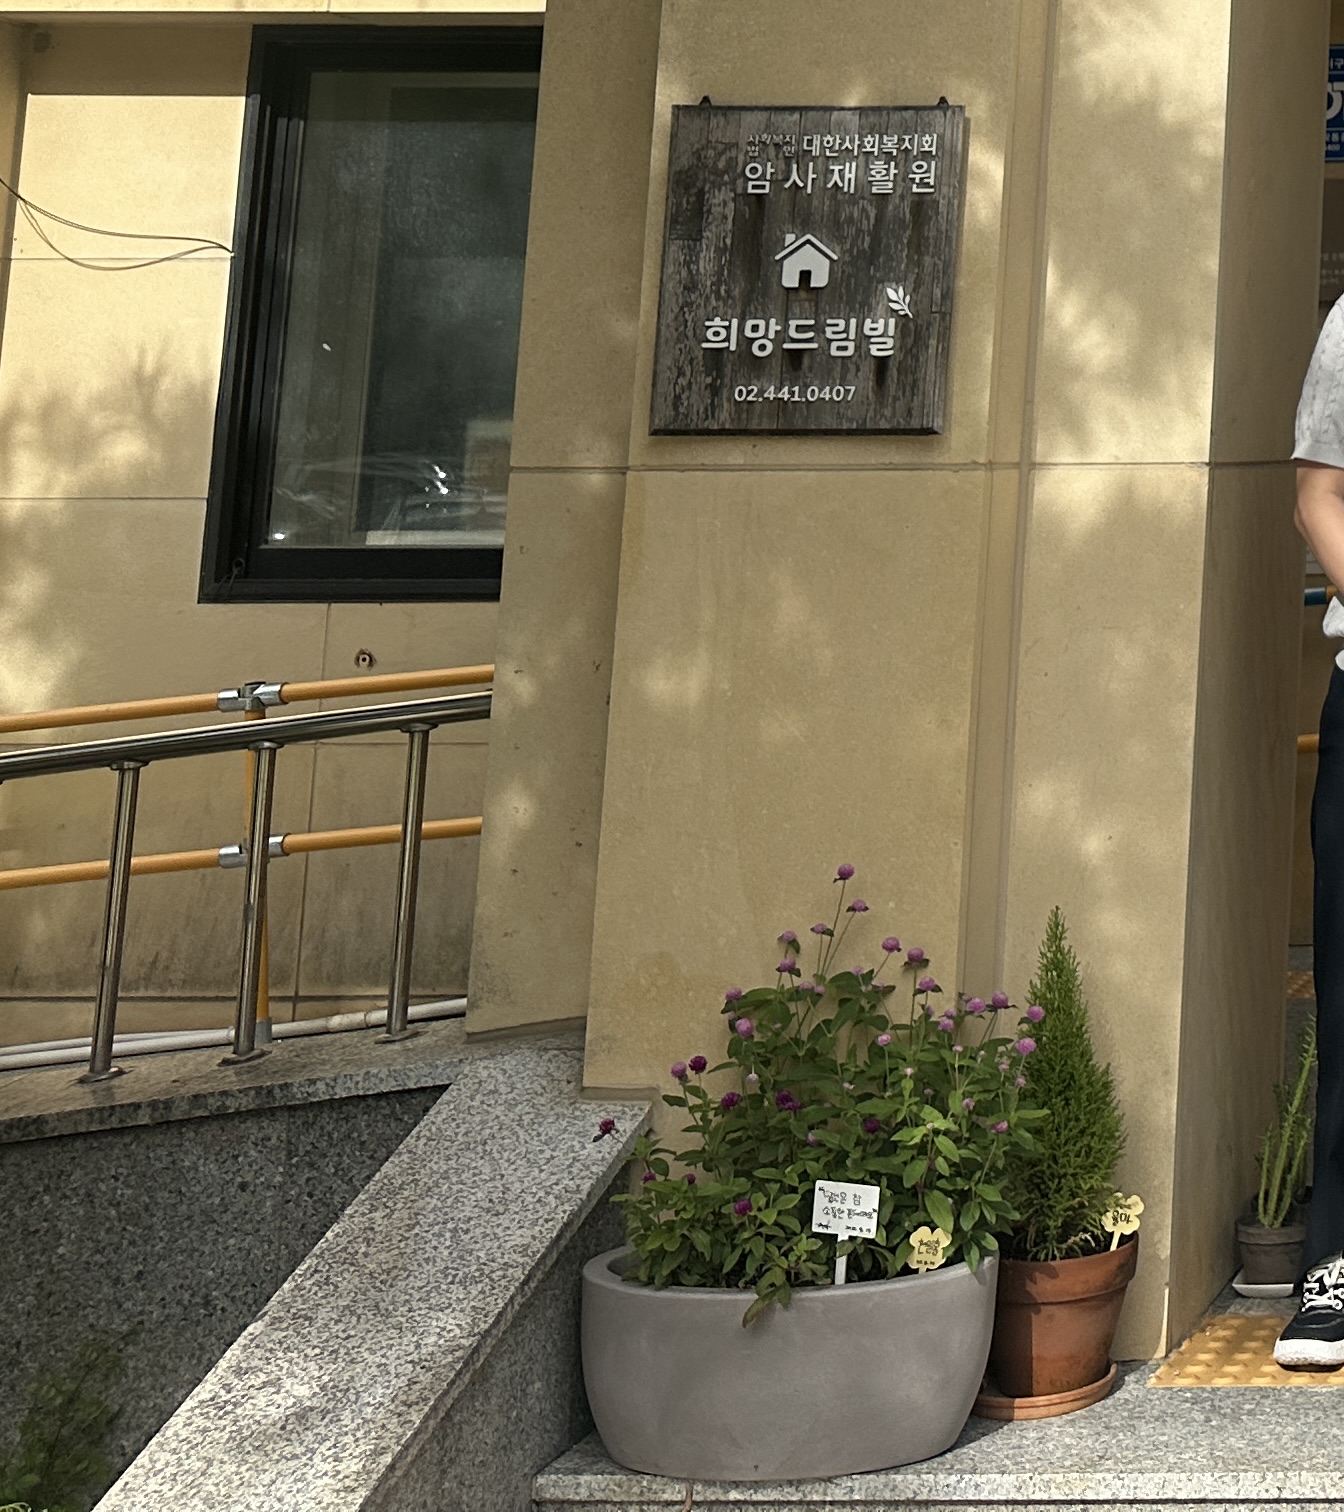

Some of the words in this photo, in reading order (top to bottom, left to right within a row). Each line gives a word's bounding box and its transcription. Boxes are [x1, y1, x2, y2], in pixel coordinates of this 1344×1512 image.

[803, 133, 938, 157] 대한사회복지회
[745, 160, 936, 194] 암사재활원
[701, 317, 896, 357] 희망드림빌
[734, 385, 856, 402] 02.441.0407
